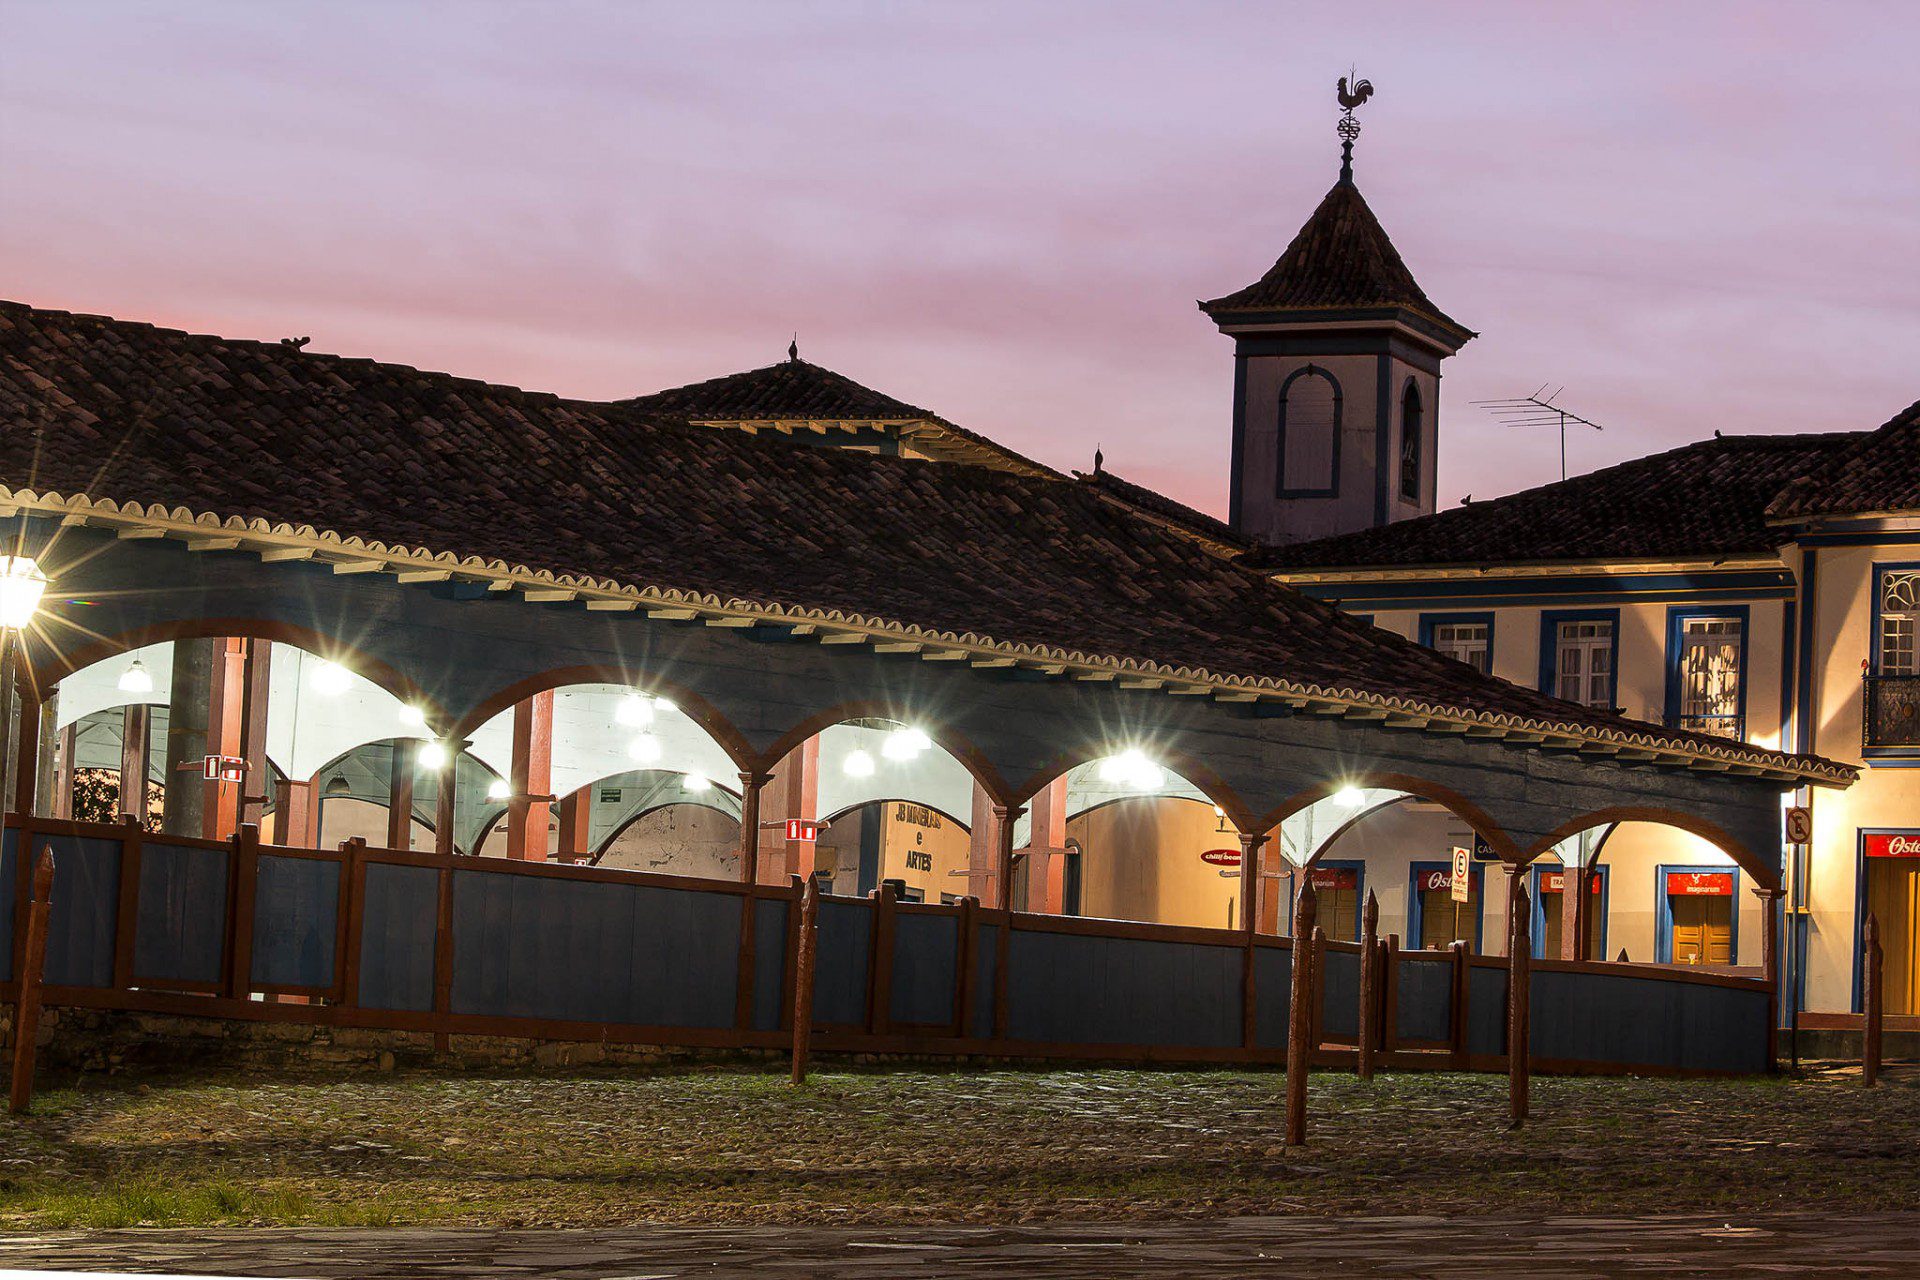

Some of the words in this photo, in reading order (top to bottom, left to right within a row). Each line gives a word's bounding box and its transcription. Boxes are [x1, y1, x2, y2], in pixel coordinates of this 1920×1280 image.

[906, 805, 941, 829] MINERAIS
[917, 831, 923, 846] e
[906, 850, 932, 872] ARTES
[1459, 855, 1464, 873] E
